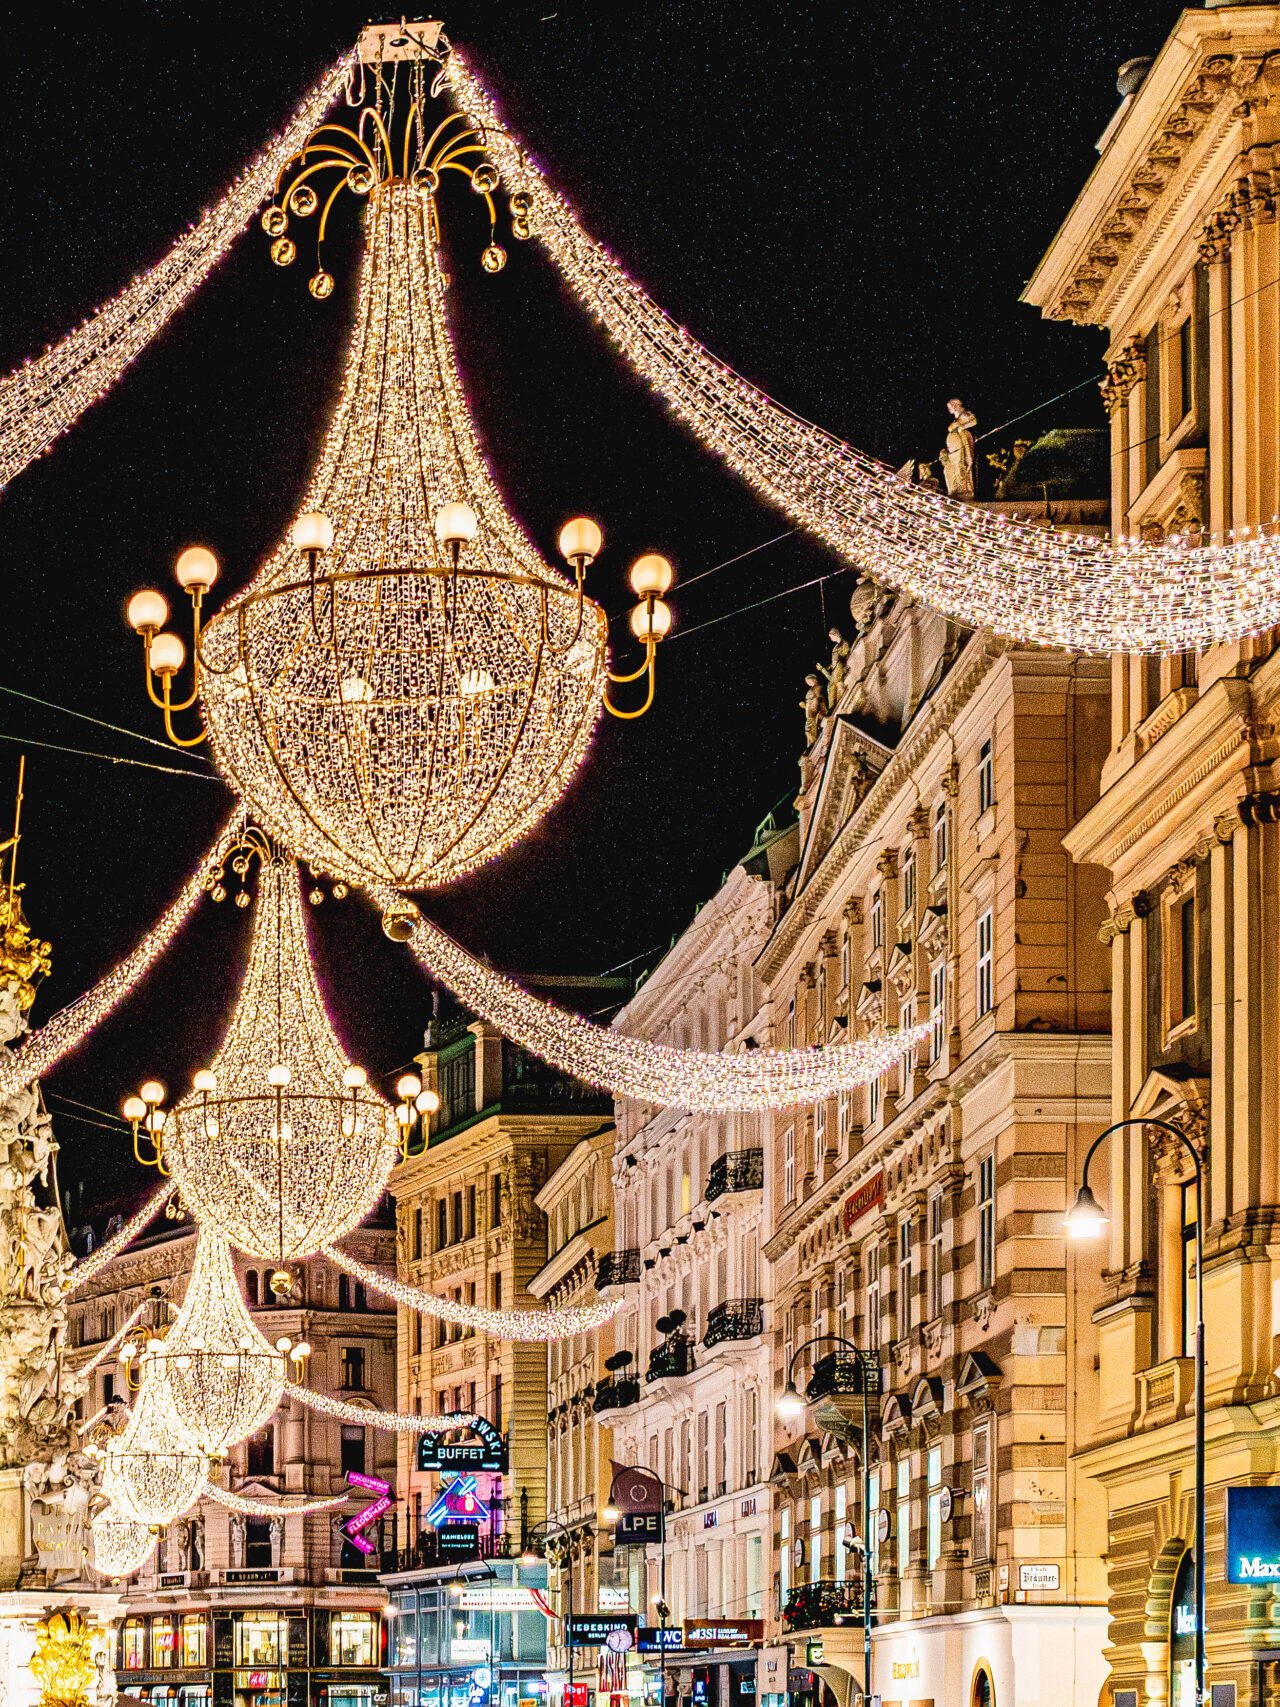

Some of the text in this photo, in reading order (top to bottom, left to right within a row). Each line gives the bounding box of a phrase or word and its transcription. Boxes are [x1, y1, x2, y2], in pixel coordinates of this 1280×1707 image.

[437, 1448, 486, 1459] BUFFET
[349, 1499, 391, 1534] FLEDERMAUS
[622, 1516, 657, 1532] LPE
[1238, 1556, 1280, 1578] Max
[566, 1623, 628, 1632] LIEBESKIND
